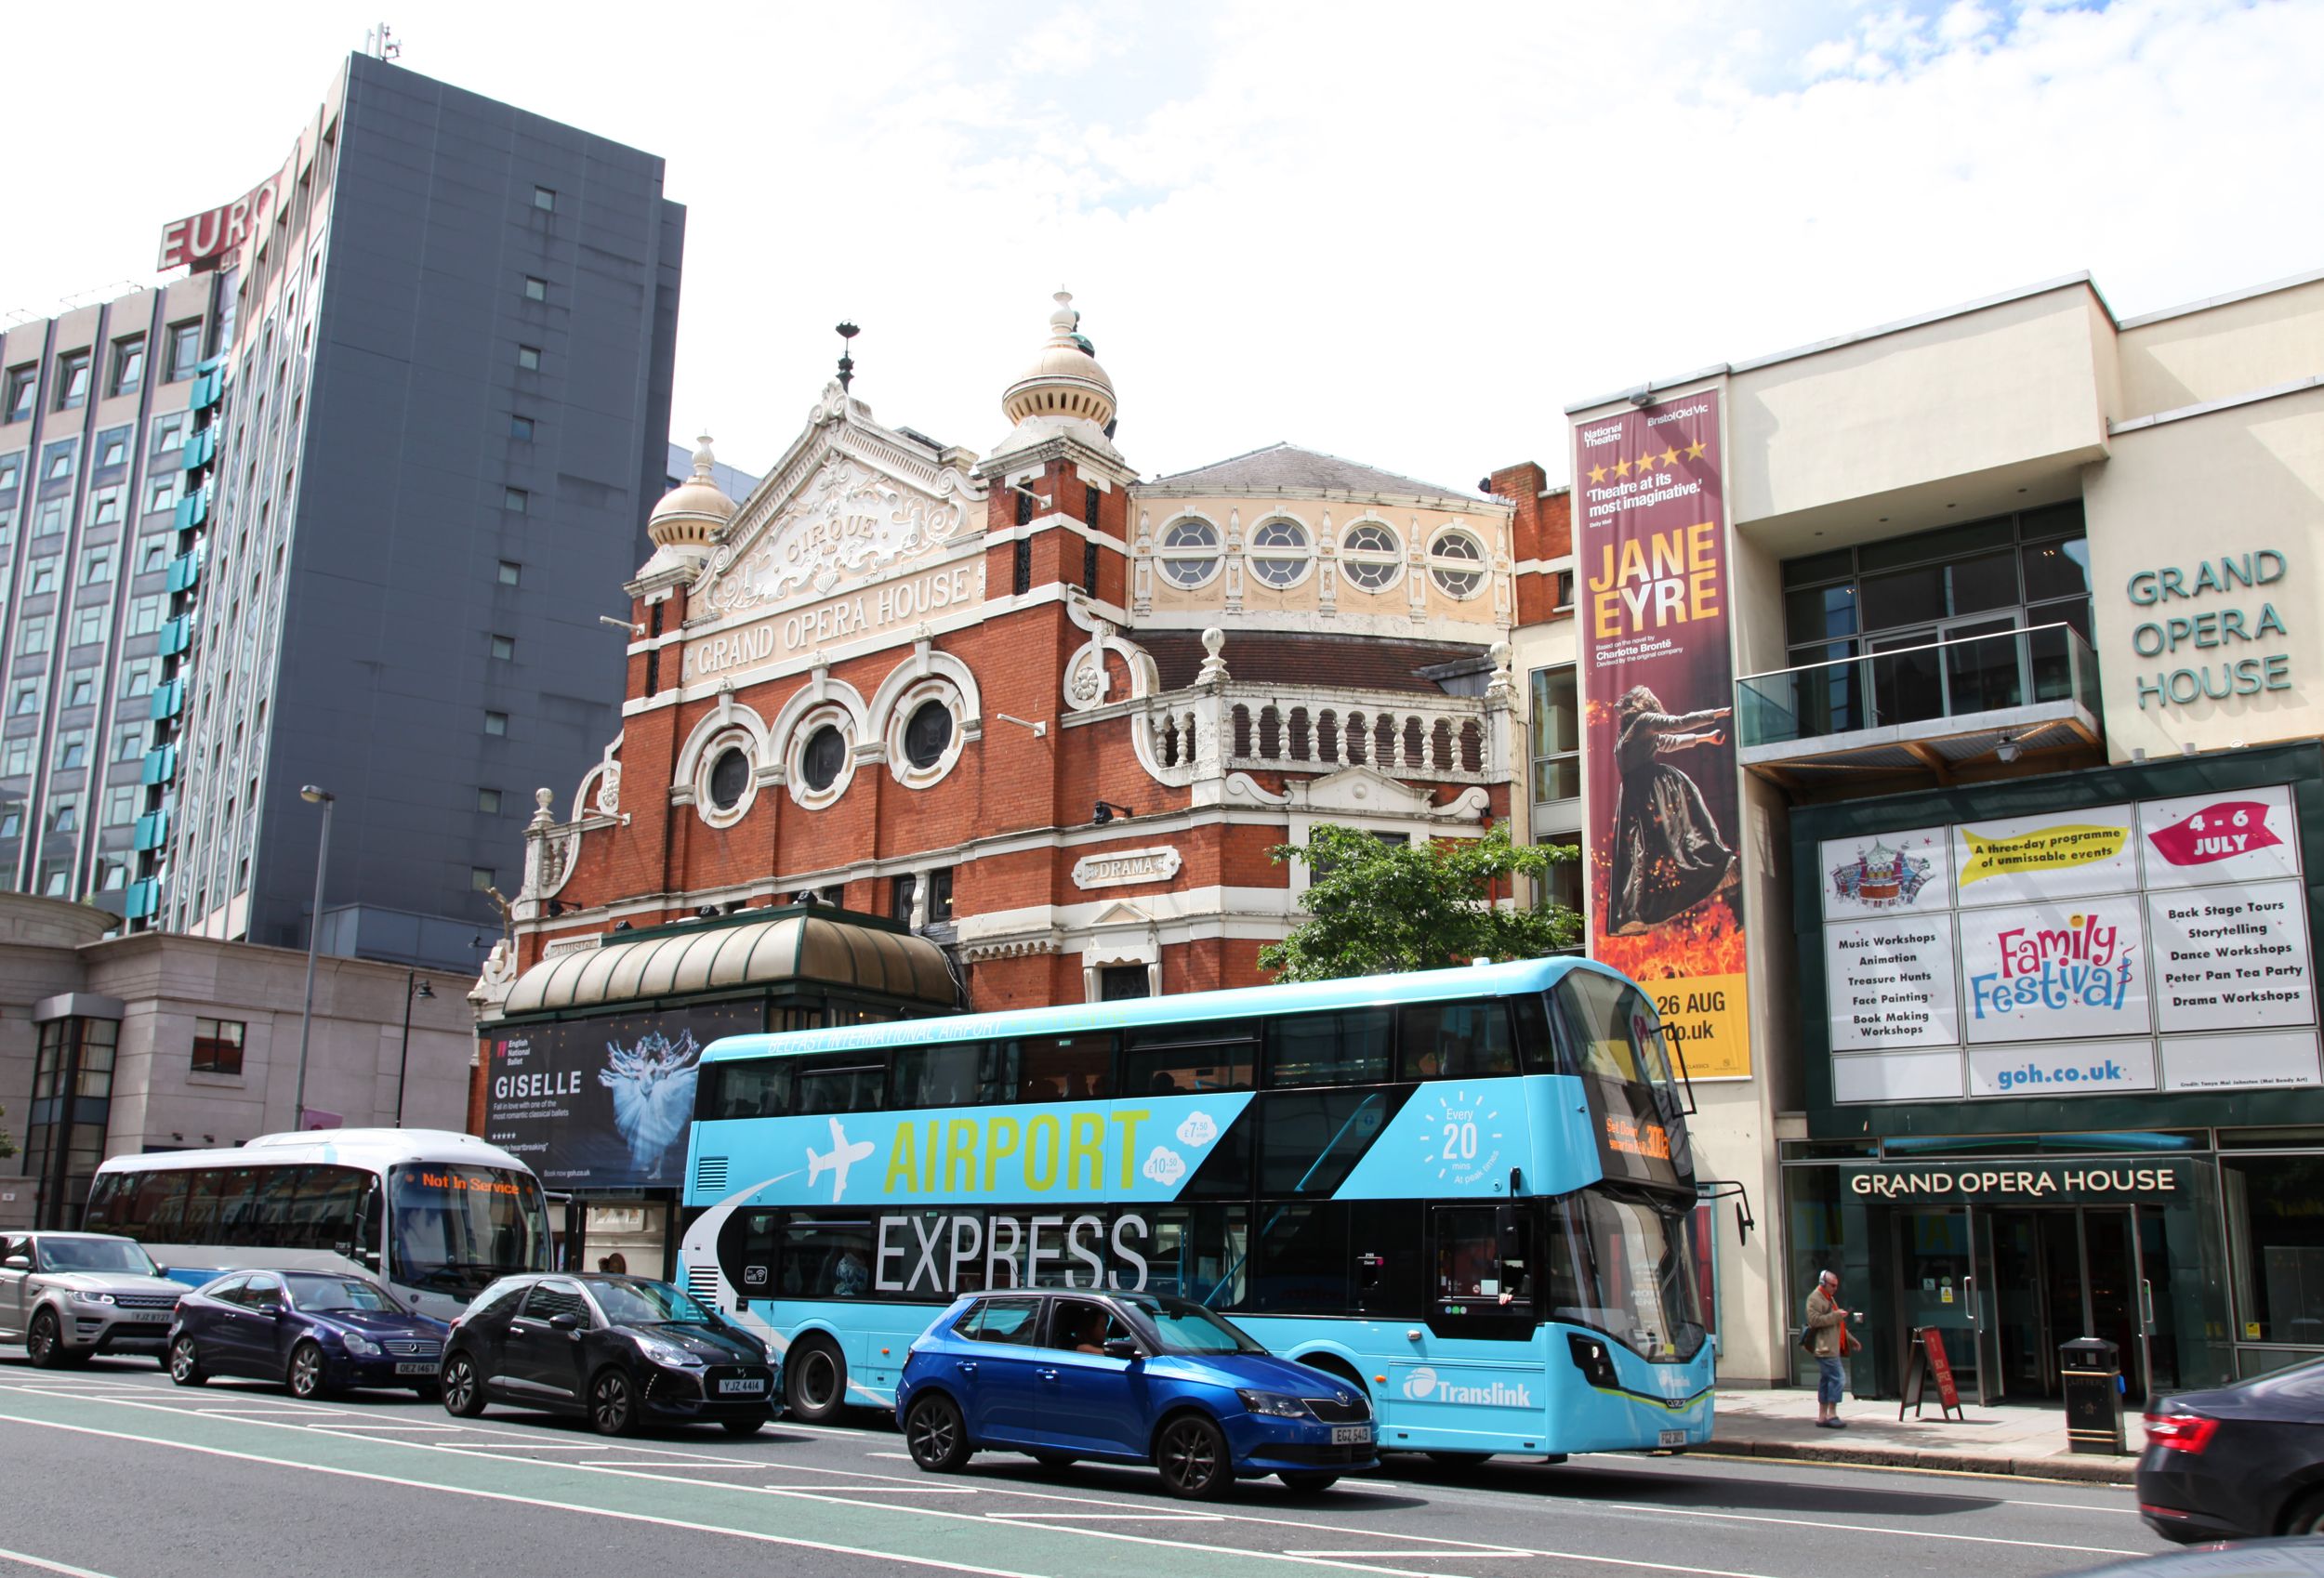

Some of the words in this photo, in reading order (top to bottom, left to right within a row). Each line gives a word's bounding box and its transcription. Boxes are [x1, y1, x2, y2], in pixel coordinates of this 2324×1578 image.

[1647, 412, 1675, 427] Bristol
[1676, 407, 1692, 419] Old
[1694, 404, 1709, 414] Vic
[1584, 423, 1622, 441] National
[1585, 433, 1621, 448] Theatre
[1640, 476, 1653, 488] at
[1656, 472, 1671, 487] its
[1590, 502, 1620, 518] most
[787, 514, 878, 563] CIRQUE
[822, 544, 838, 557] AND
[1589, 521, 1716, 593] JANE
[2127, 549, 2287, 606] GRAND
[1594, 569, 1719, 639] EYRE
[698, 625, 774, 675] GRAND
[784, 597, 868, 651] OPERA
[877, 566, 971, 625] HOUSE
[2133, 602, 2287, 658] OPERA
[1596, 642, 1613, 651] Based
[1622, 638, 1631, 646] the
[1632, 636, 1646, 644] novel
[1596, 646, 1638, 661] Charlotte
[1640, 638, 1671, 652] Brontë
[1596, 658, 1618, 667] Devised
[1618, 657, 1626, 665] by
[1627, 654, 1636, 663] the
[1636, 651, 1657, 662] original
[1657, 646, 1684, 658] company
[2136, 653, 2291, 710] HOUSE
[2189, 815, 2205, 832] 4
[2233, 809, 2249, 827] 6
[1975, 845, 1984, 854] A
[1987, 838, 2045, 853] three-day
[2050, 829, 2120, 848] programme
[2194, 834, 2248, 856] JULY
[1100, 857, 1154, 879] DRAMA
[1981, 857, 1993, 868] of
[1998, 852, 2066, 865] unmissable
[2071, 847, 2112, 860] events
[2168, 907, 2199, 919] Back
[2204, 904, 2242, 916] Stage
[2247, 901, 2284, 913] Tours
[2188, 923, 2267, 939] Storytelling
[1839, 938, 1869, 950] Music
[1873, 934, 1935, 946] Workshops
[1997, 914, 2117, 979] Family
[2171, 949, 2211, 961] Dance
[2215, 943, 2292, 957] Workshops
[1859, 953, 1917, 967] Animation
[1848, 975, 1895, 986] Treasure
[1899, 972, 1932, 982] Hunts
[2165, 972, 2200, 983] Peter
[2206, 969, 2231, 980] Pan
[2236, 967, 2260, 978] Tea
[2265, 965, 2303, 977] Party
[1970, 957, 2128, 1019] Festival
[2172, 995, 2217, 1006] Drama
[2222, 990, 2300, 1004] Workshops
[1657, 994, 1680, 1016] 26
[1686, 991, 1725, 1014] AUG
[1853, 996, 1877, 1006] Face
[1881, 992, 1928, 1003] Painting
[1854, 1013, 1882, 1024] Book
[1886, 1010, 1929, 1022] Making
[767, 1035, 824, 1054] BELFAST
[827, 1026, 933, 1048] INTERNATIONAL
[938, 1019, 1002, 1039] AIRPORT
[1860, 1025, 1923, 1037] Workshops
[508, 1039, 528, 1048] English
[508, 1048, 530, 1057] National
[507, 1058, 522, 1066] Ballet
[495, 1071, 581, 1098] GISELLE
[1998, 1059, 2121, 1090] goh.co.uk
[528, 1110, 550, 1118] classical
[550, 1109, 569, 1117] ballets
[548, 1099, 556, 1108] the
[1446, 1108, 1473, 1122] Every
[884, 1110, 1150, 1193] AIRPORT
[1443, 1122, 1477, 1160] 20
[1454, 1175, 1463, 1184] At
[1465, 1170, 1484, 1185] peak
[1483, 1150, 1499, 1172] times
[423, 1173, 448, 1188] Not
[453, 1176, 467, 1190] In
[469, 1177, 520, 1195] Service
[1852, 1174, 1953, 1199] GRAND
[1958, 1170, 2057, 1197] OPERA
[2064, 1168, 2175, 1191] HOUSE
[875, 1214, 1148, 1293] EXPRESS
[400, 1364, 416, 1373] OEZ
[724, 1381, 741, 1391] YJZ
[742, 1381, 759, 1391] 4414
[1437, 1381, 1531, 1408] Translink
[1337, 1429, 1352, 1441] EGZ
[1353, 1428, 1367, 1440] 5413
